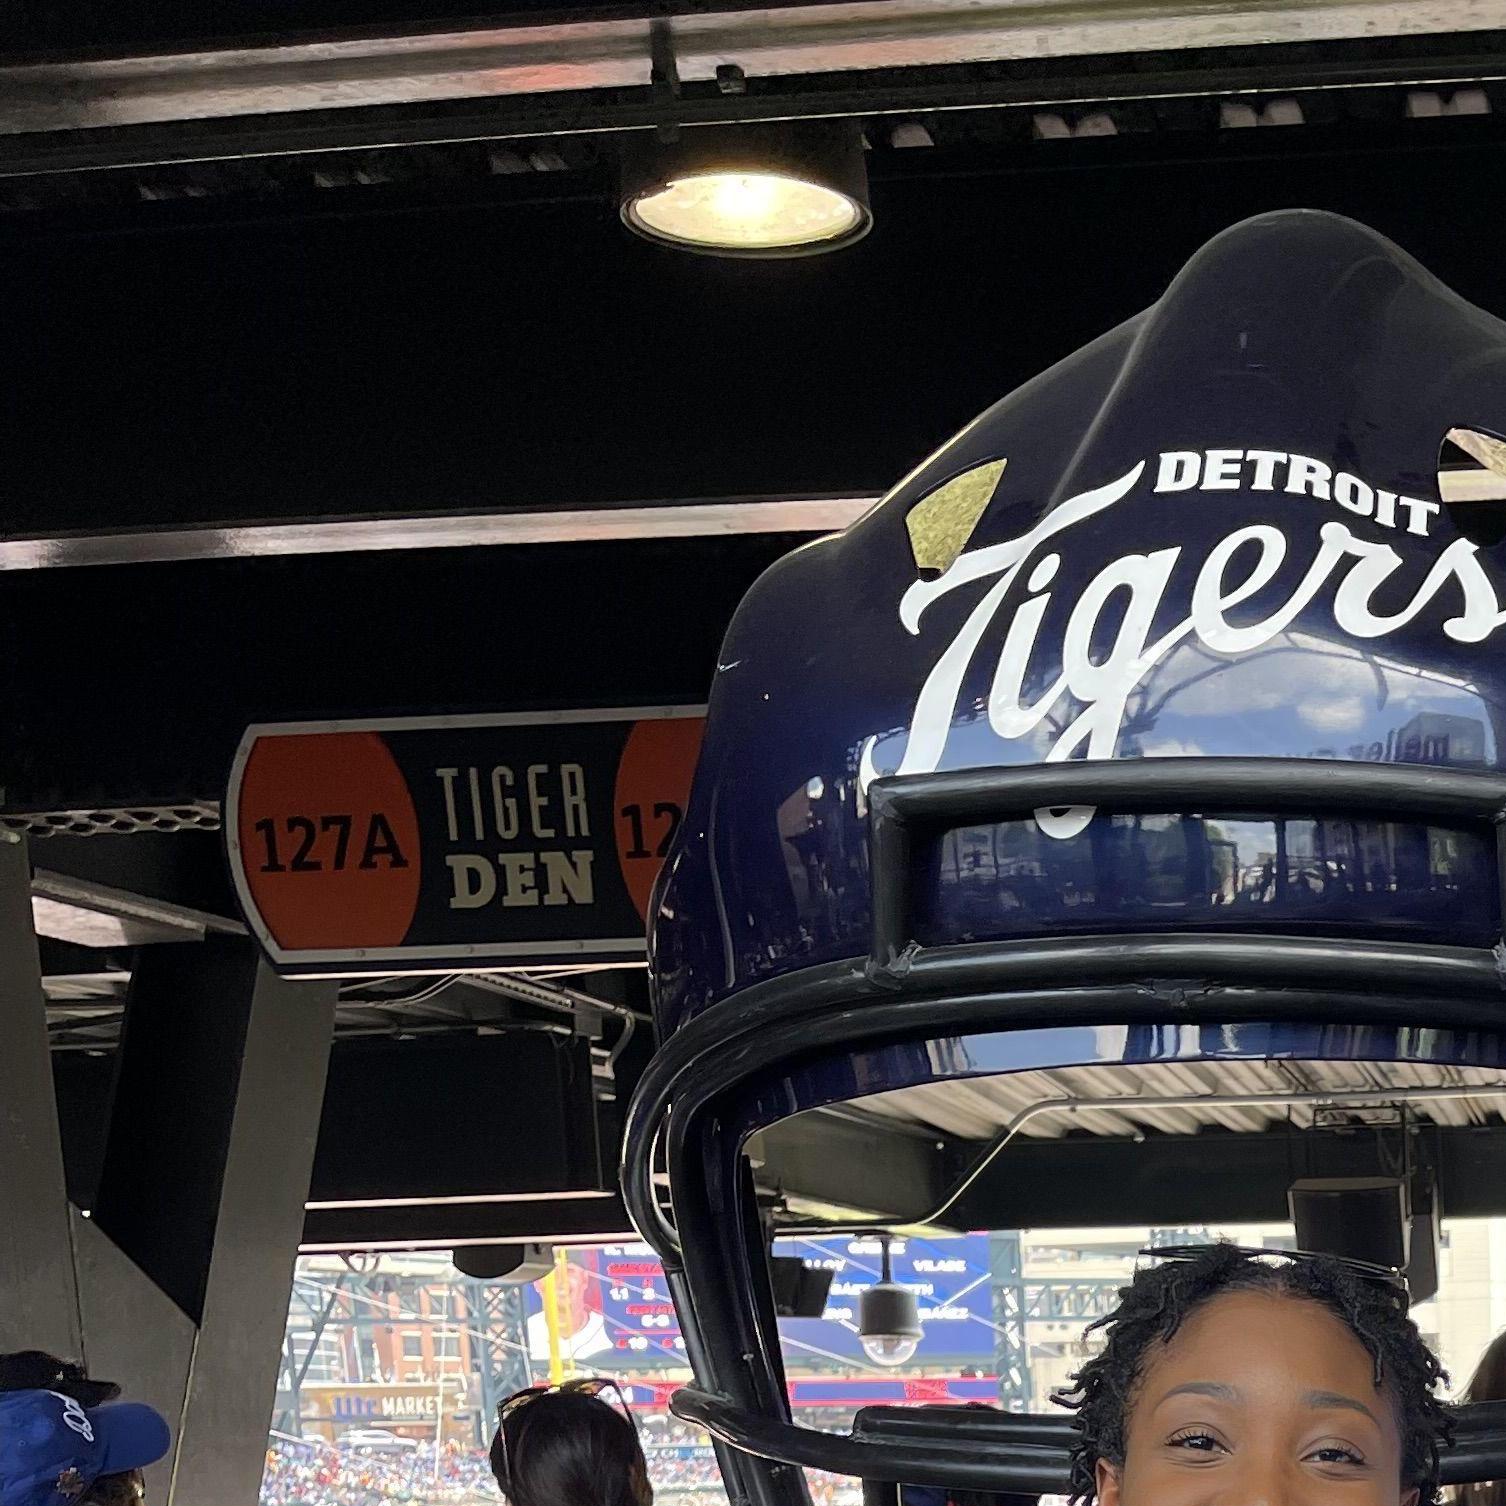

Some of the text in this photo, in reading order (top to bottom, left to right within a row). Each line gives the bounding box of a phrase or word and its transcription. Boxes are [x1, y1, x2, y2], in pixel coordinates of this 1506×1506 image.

[1153, 448, 1440, 537] DETROIT
[436, 761, 591, 841] TIGER
[621, 803, 685, 859] 12
[255, 814, 408, 873] 127A
[445, 849, 596, 910] DEN
